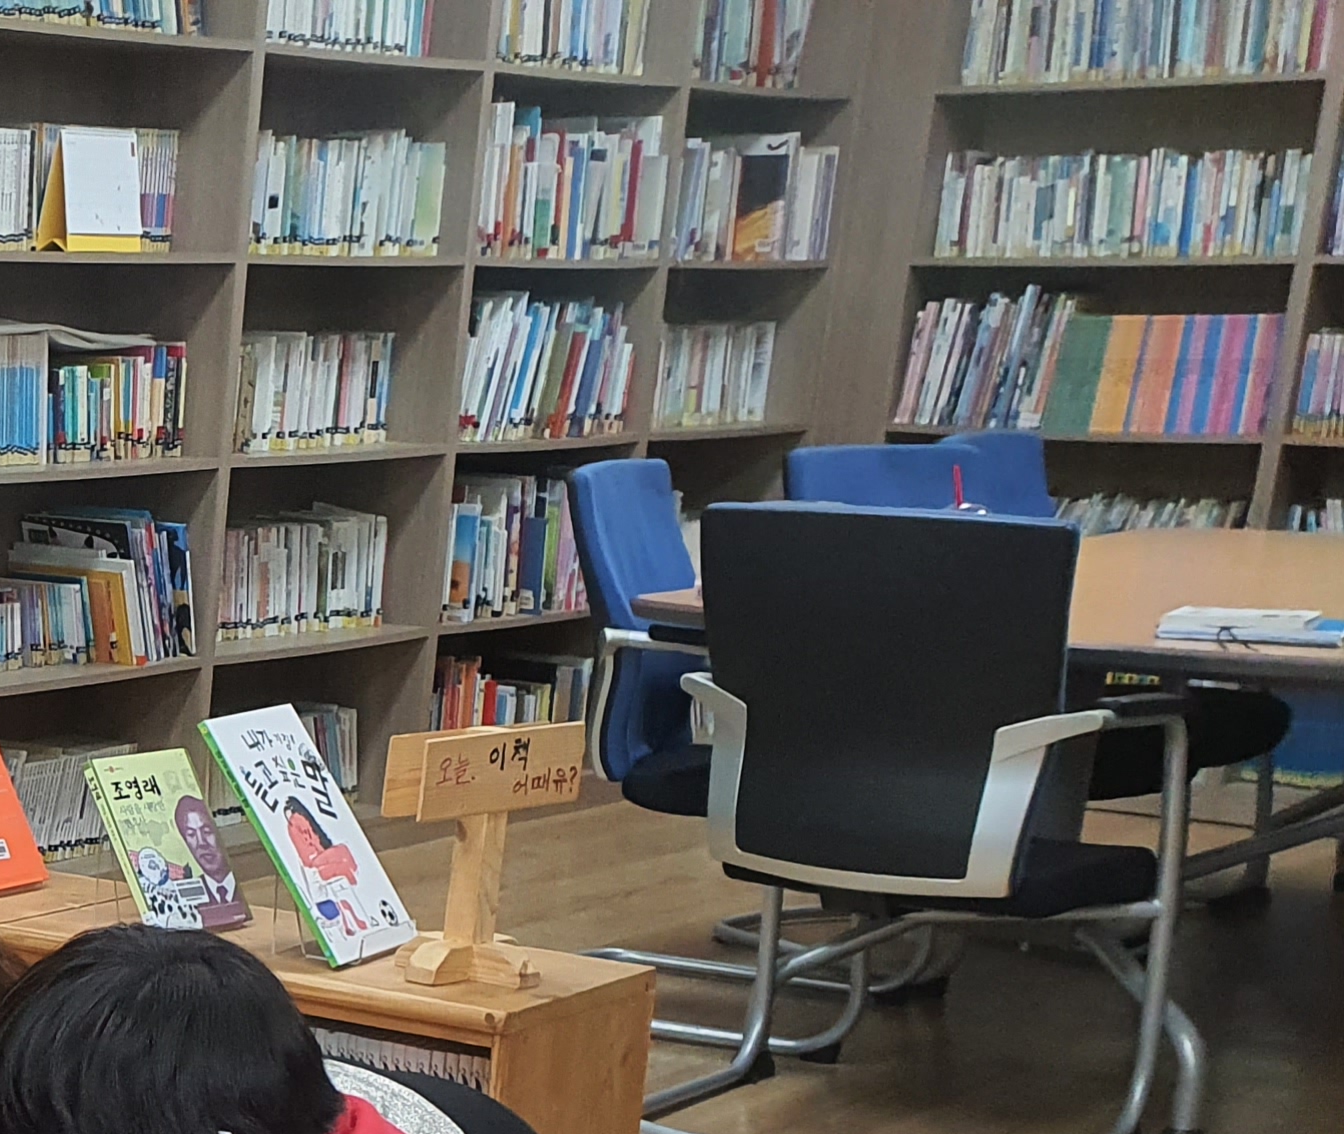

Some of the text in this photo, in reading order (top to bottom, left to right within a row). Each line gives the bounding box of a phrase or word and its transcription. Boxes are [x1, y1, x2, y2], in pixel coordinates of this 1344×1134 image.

[240, 729, 273, 752] 내가
[435, 737, 531, 786] 오늘. 이 책
[110, 774, 162, 800] 조영래
[301, 759, 338, 820] 말
